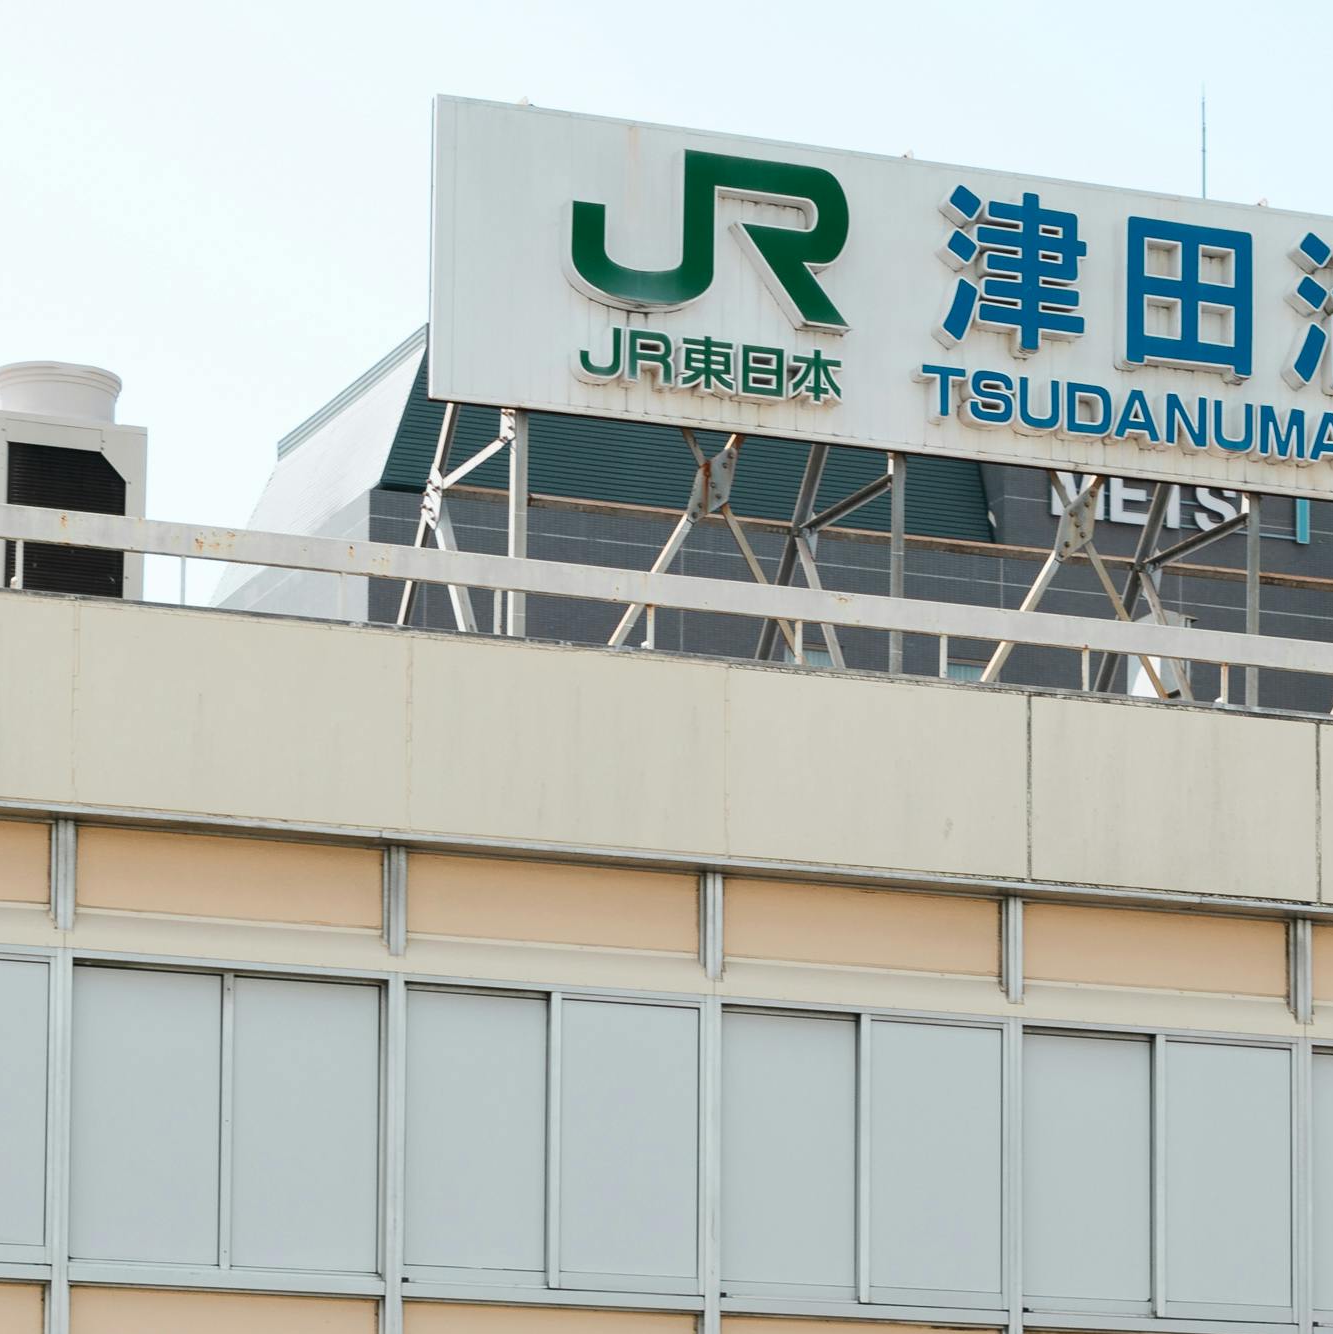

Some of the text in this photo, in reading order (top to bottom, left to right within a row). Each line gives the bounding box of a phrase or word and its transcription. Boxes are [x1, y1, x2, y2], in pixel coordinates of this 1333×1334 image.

[570, 148, 851, 328] JR
[579, 327, 843, 402] JR東日本
